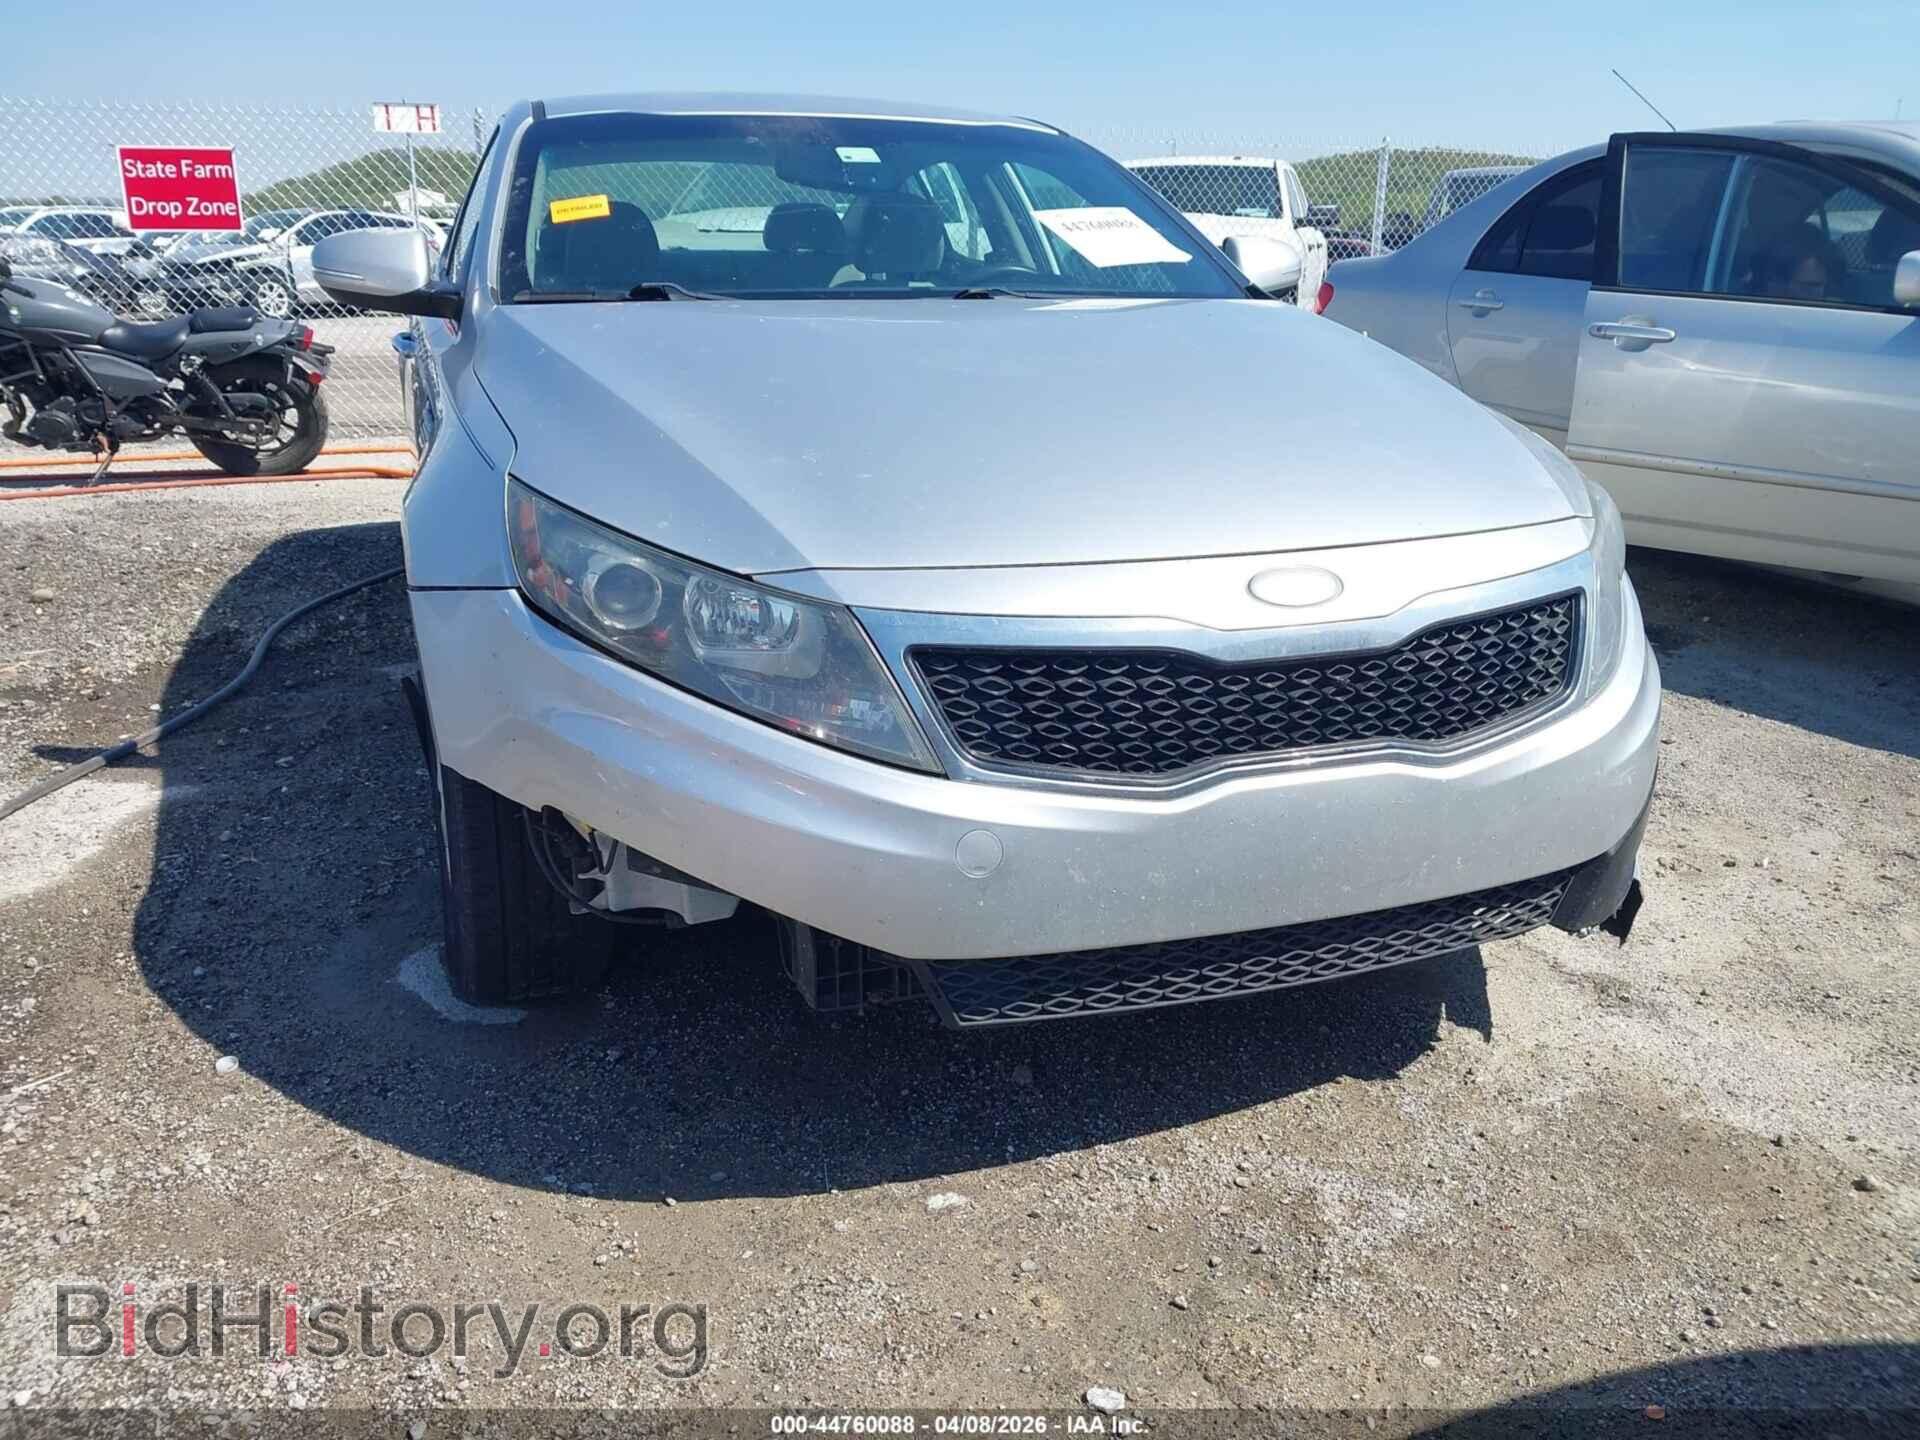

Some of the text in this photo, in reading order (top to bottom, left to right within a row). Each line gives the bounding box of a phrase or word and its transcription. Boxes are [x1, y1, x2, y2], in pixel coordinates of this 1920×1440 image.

[415, 105, 436, 131] H
[123, 159, 232, 178] State Farm
[130, 196, 237, 219] Drop Zone
